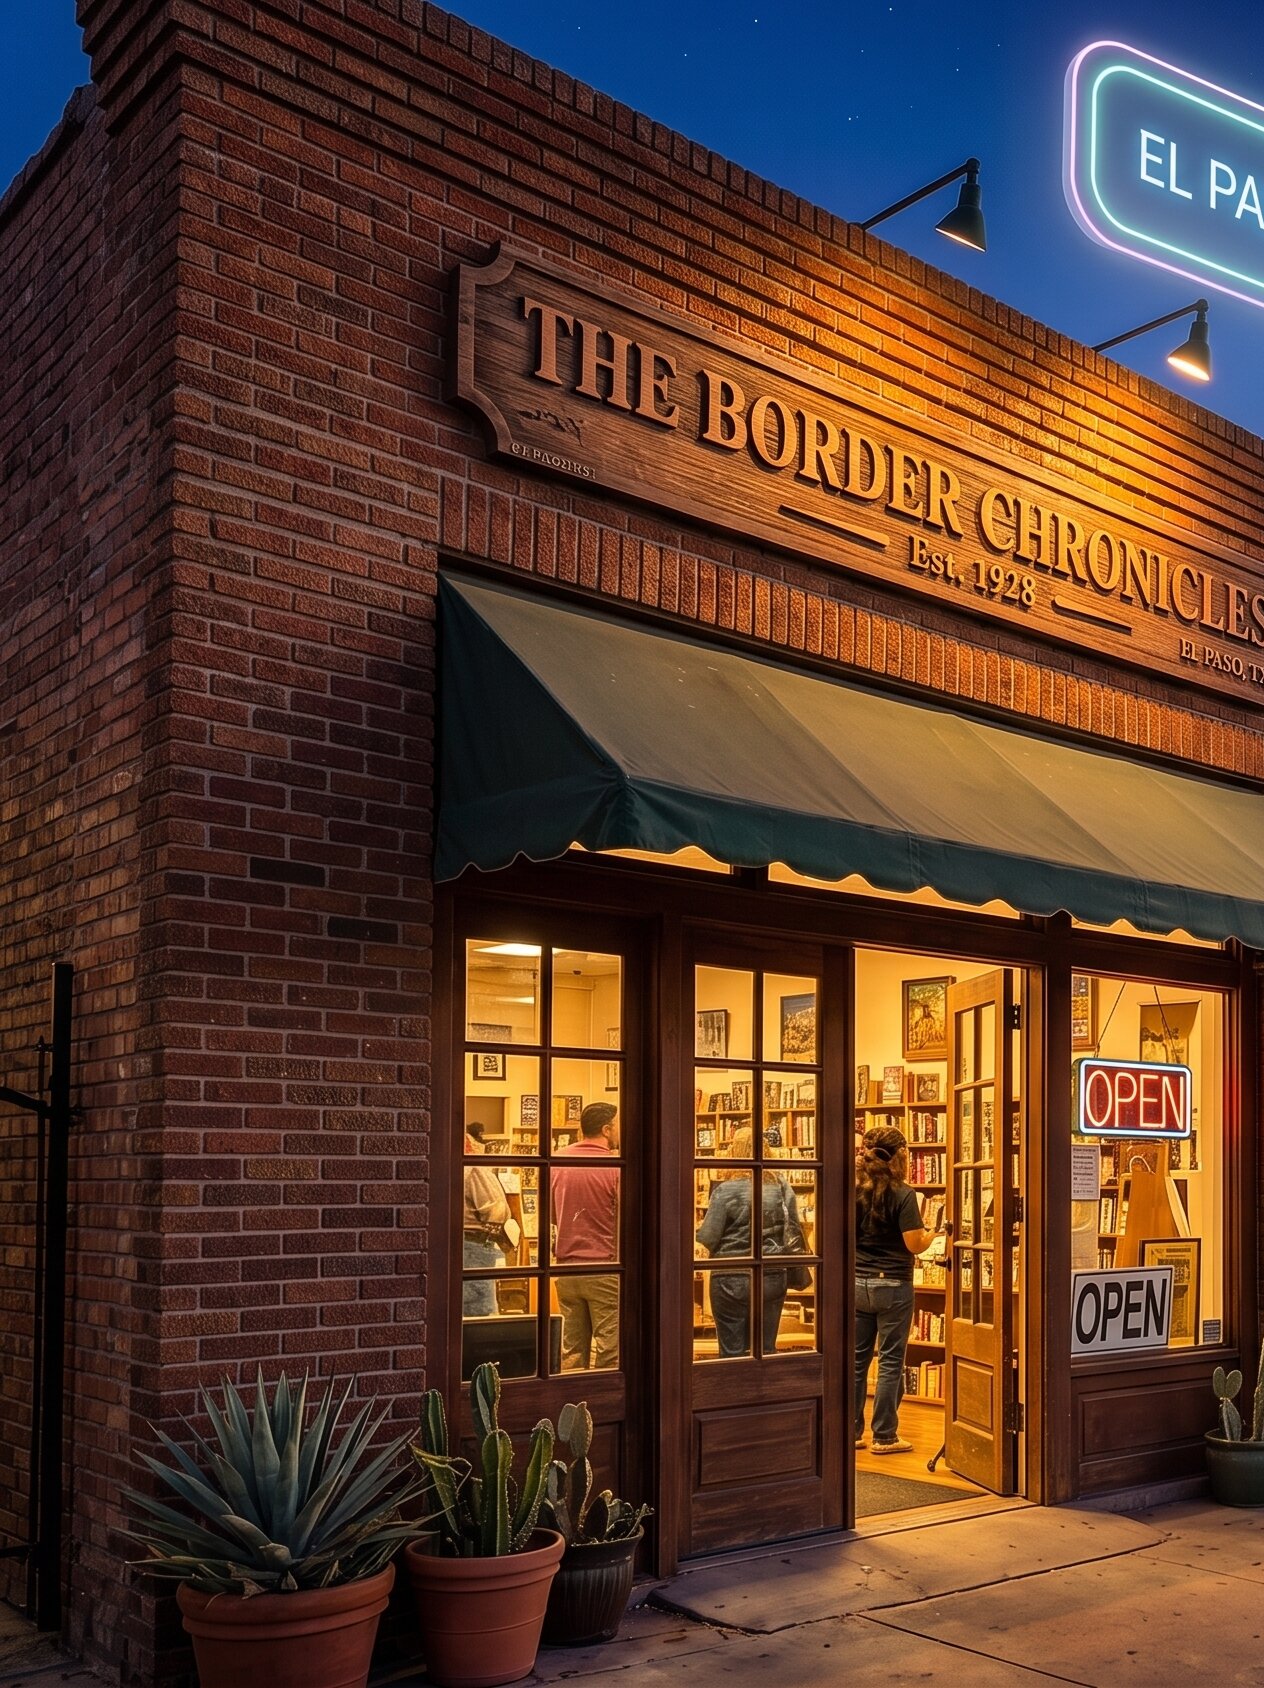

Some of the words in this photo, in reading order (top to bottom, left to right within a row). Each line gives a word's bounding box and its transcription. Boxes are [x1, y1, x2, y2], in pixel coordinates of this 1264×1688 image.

[1139, 128, 1193, 201] EL
[522, 296, 680, 429] THE
[699, 369, 964, 538] BORDER
[909, 534, 965, 585] Est.
[973, 558, 1037, 609] 1928
[1180, 638, 1199, 662] EL
[1203, 648, 1247, 682] PASO,
[1084, 1068, 1185, 1130] OPEN
[1075, 1277, 1168, 1345] OPEN
